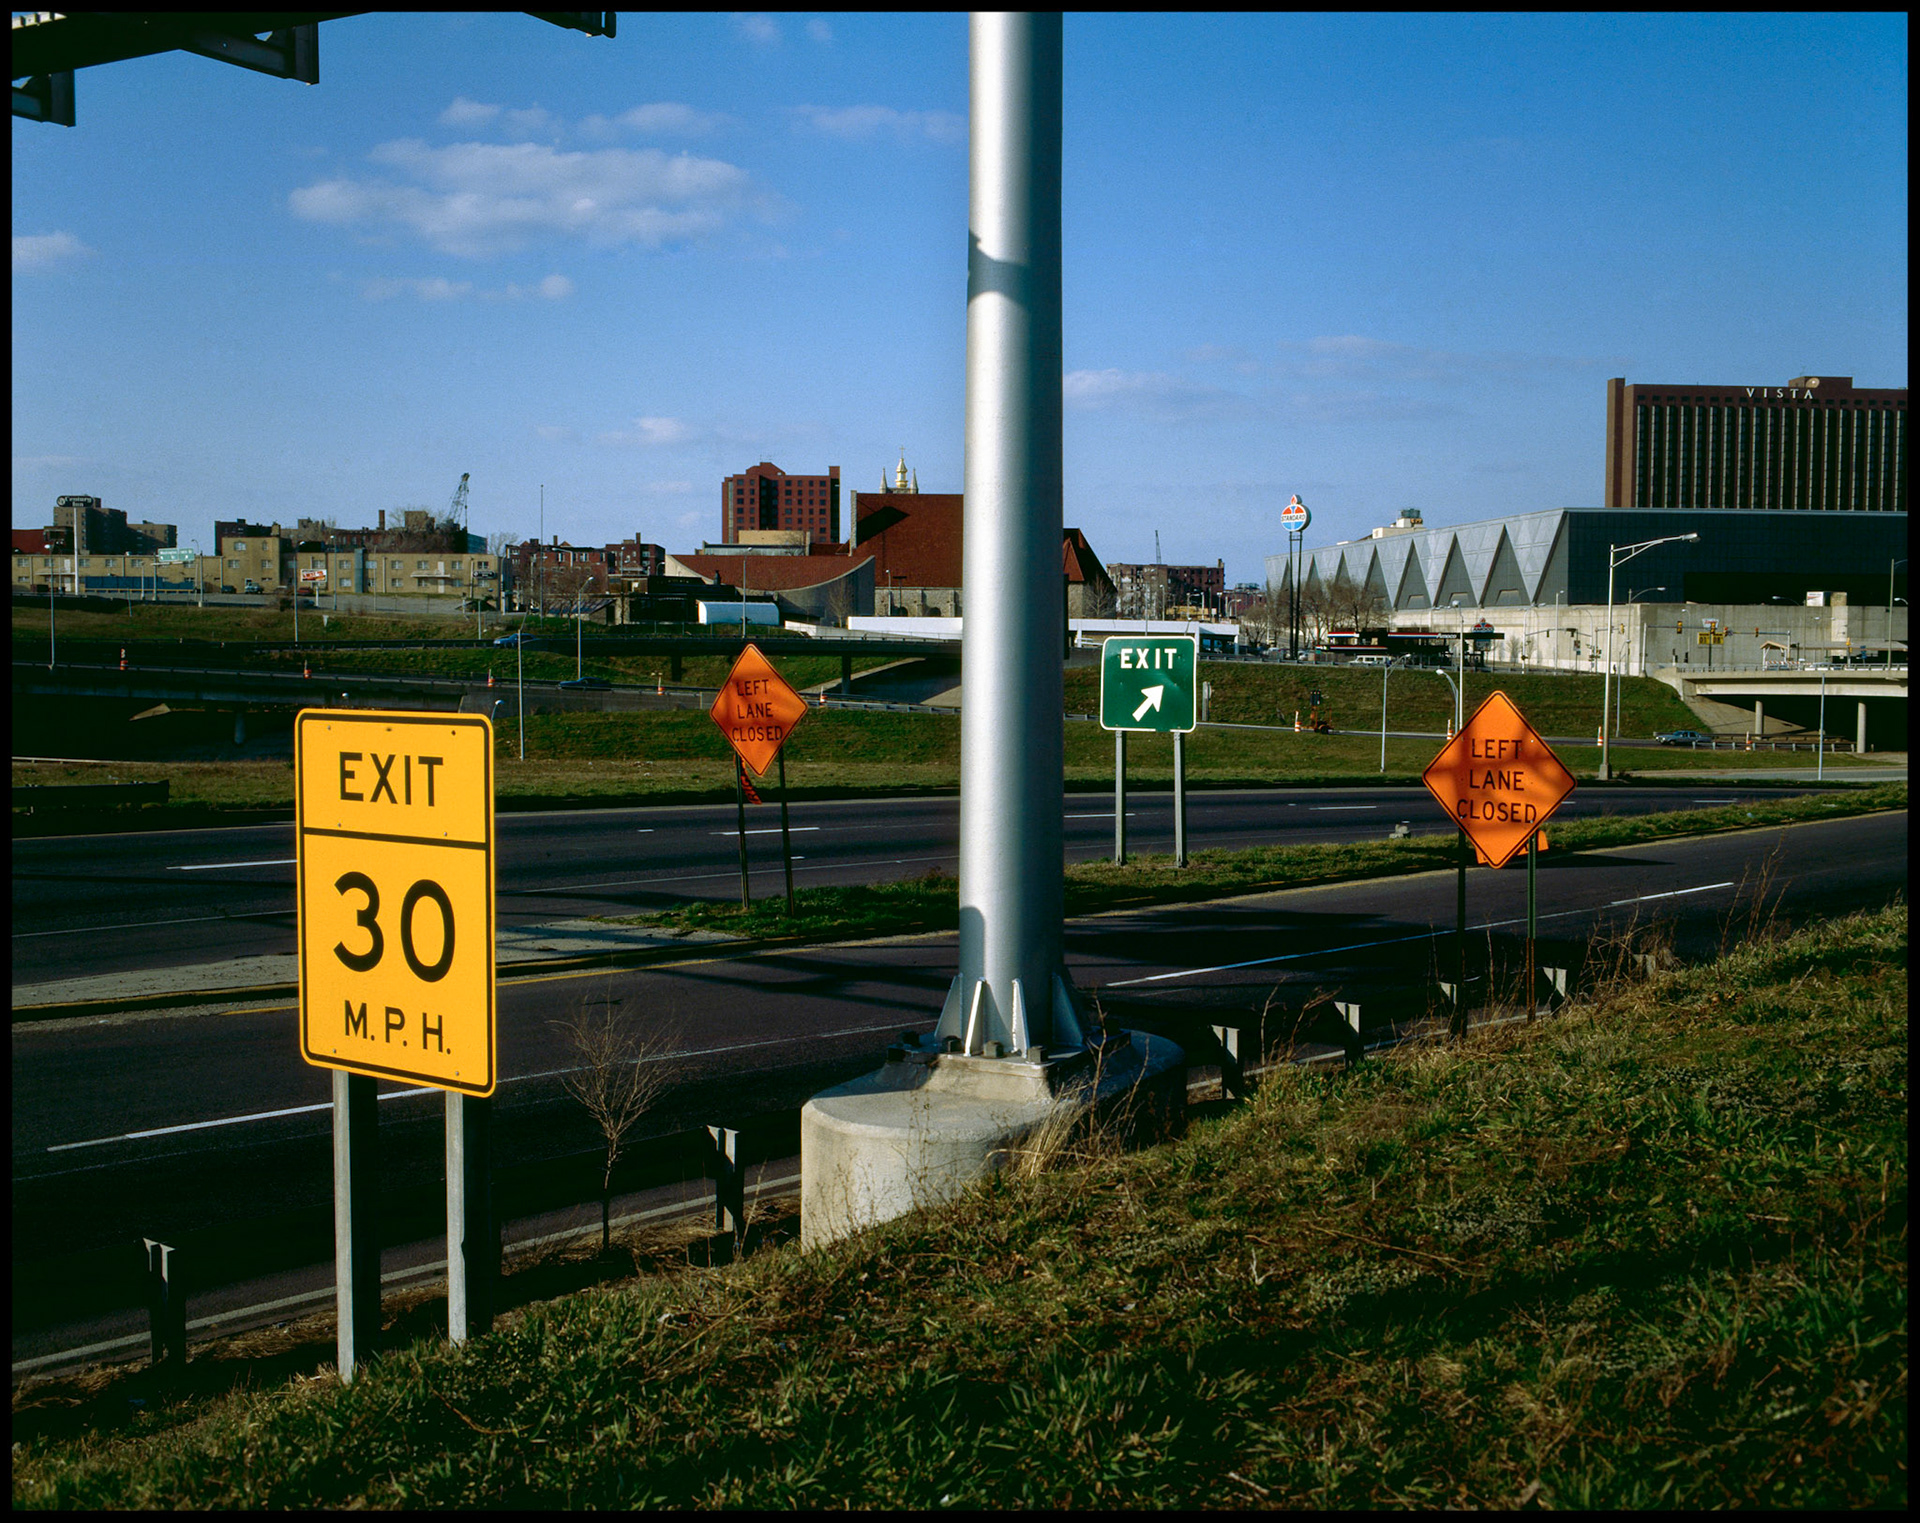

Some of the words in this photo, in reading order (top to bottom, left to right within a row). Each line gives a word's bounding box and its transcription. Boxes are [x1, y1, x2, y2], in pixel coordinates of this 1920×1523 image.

[1746, 387, 1813, 400] VISTA
[1281, 514, 1306, 522] STANDARD
[1120, 648, 1178, 669] EXIT
[736, 679, 769, 696] LEFT
[737, 702, 773, 719] LANE
[732, 726, 783, 742] CLOSED
[1471, 738, 1523, 759] LEFT
[339, 751, 444, 807] EXIT
[1469, 769, 1524, 791] LANE
[1457, 799, 1537, 823] CLOSED
[334, 871, 456, 983] 30
